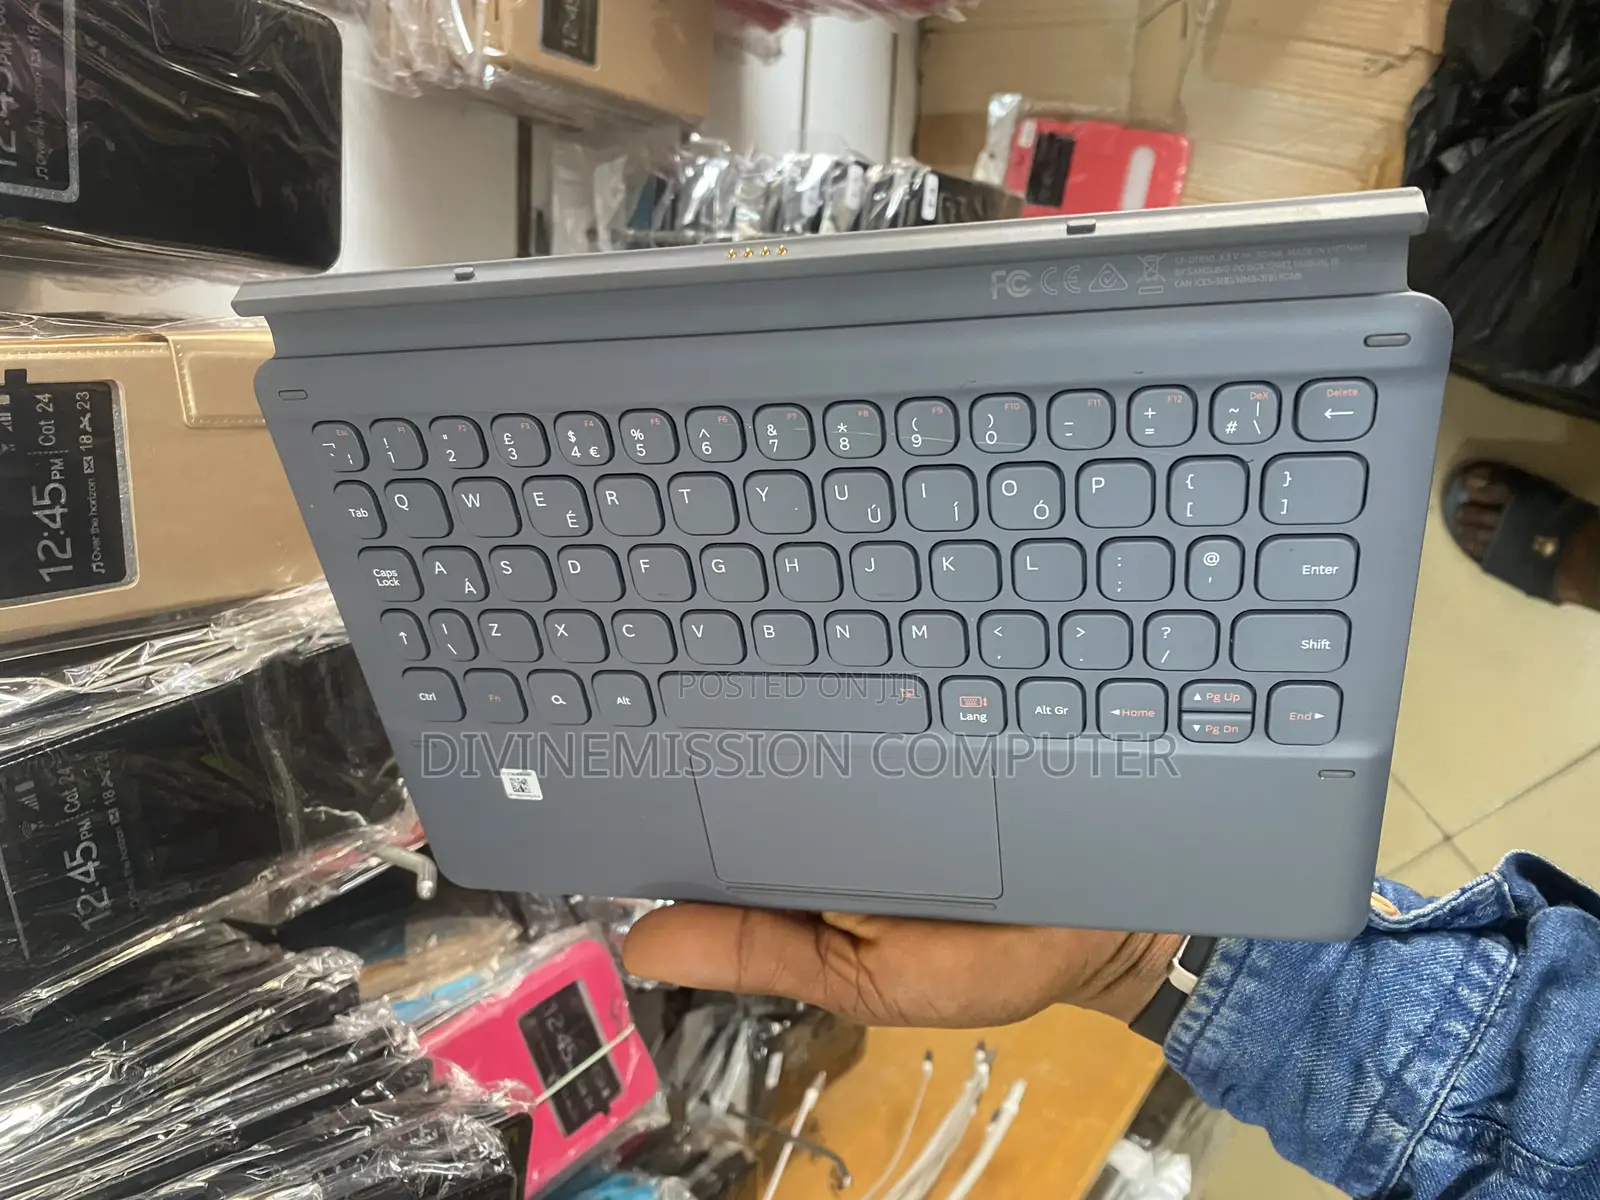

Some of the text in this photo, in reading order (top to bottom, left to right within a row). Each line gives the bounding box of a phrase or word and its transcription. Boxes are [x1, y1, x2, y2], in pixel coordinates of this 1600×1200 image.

[1174, 279, 1192, 288] CAN
[1250, 392, 1269, 400] DeX
[1327, 389, 1358, 397] Delete
[35, 393, 53, 412] 24
[76, 391, 90, 410] 23
[1144, 408, 1156, 418] +
[912, 418, 918, 431] (
[988, 414, 993, 428] )
[1225, 421, 1237, 434] #
[568, 430, 576, 443] $
[631, 429, 644, 440] %
[767, 424, 777, 436] &
[79, 434, 93, 451] 18
[383, 438, 388, 448] !
[504, 433, 514, 444] £
[840, 437, 849, 450] 8
[911, 434, 922, 447] 9
[571, 446, 581, 458] 4
[589, 446, 600, 457] €
[636, 444, 645, 456] 5
[702, 442, 711, 454] 6
[769, 439, 778, 452] 7
[387, 452, 395, 463] 1
[446, 450, 456, 461] 2
[508, 448, 517, 460] 3
[1092, 477, 1105, 493] P
[1186, 474, 1194, 489] {
[1283, 471, 1292, 487] }
[533, 492, 546, 506] E
[606, 491, 619, 505] R
[678, 489, 690, 503] T
[756, 487, 768, 502] Y
[835, 485, 848, 500] U
[395, 494, 409, 510] Q
[462, 494, 480, 507] W
[1281, 499, 1287, 514] ]
[349, 508, 368, 517] Tab
[868, 504, 881, 523] Ú
[1034, 500, 1049, 519] Ó
[1187, 502, 1193, 517] [
[32, 458, 73, 582] 12:45 PM
[87, 479, 102, 561] Over the horizon
[566, 510, 579, 527] É
[785, 558, 799, 572] H
[865, 558, 874, 572] J
[943, 557, 955, 571] K
[1027, 556, 1038, 570] L
[1203, 552, 1219, 566] @
[435, 562, 447, 574] A
[500, 561, 512, 574] S
[568, 560, 580, 573] D
[640, 560, 649, 573] F
[712, 559, 725, 573] G
[1303, 565, 1339, 574] Enter
[373, 569, 398, 578] Caps
[376, 578, 400, 586] Lock
[465, 578, 476, 594] Á
[489, 624, 501, 636] Z
[555, 624, 568, 636] X
[622, 624, 635, 637] C
[692, 625, 703, 637] V
[763, 625, 775, 638] B
[836, 625, 849, 638] N
[912, 625, 927, 638] M
[994, 627, 1002, 636] <
[1077, 627, 1085, 637] >
[1162, 627, 1171, 638] ?
[1301, 639, 1330, 649] Shift
[617, 696, 631, 705] Alt
[1206, 693, 1240, 703] Pg Up
[1035, 705, 1051, 714] Alt
[1122, 709, 1155, 717] Home
[1290, 712, 1312, 720] End
[960, 712, 987, 723] Lang
[1205, 725, 1238, 735] Pg Dn
[102, 789, 116, 807] 18
[63, 818, 112, 929] 12:45 PM
